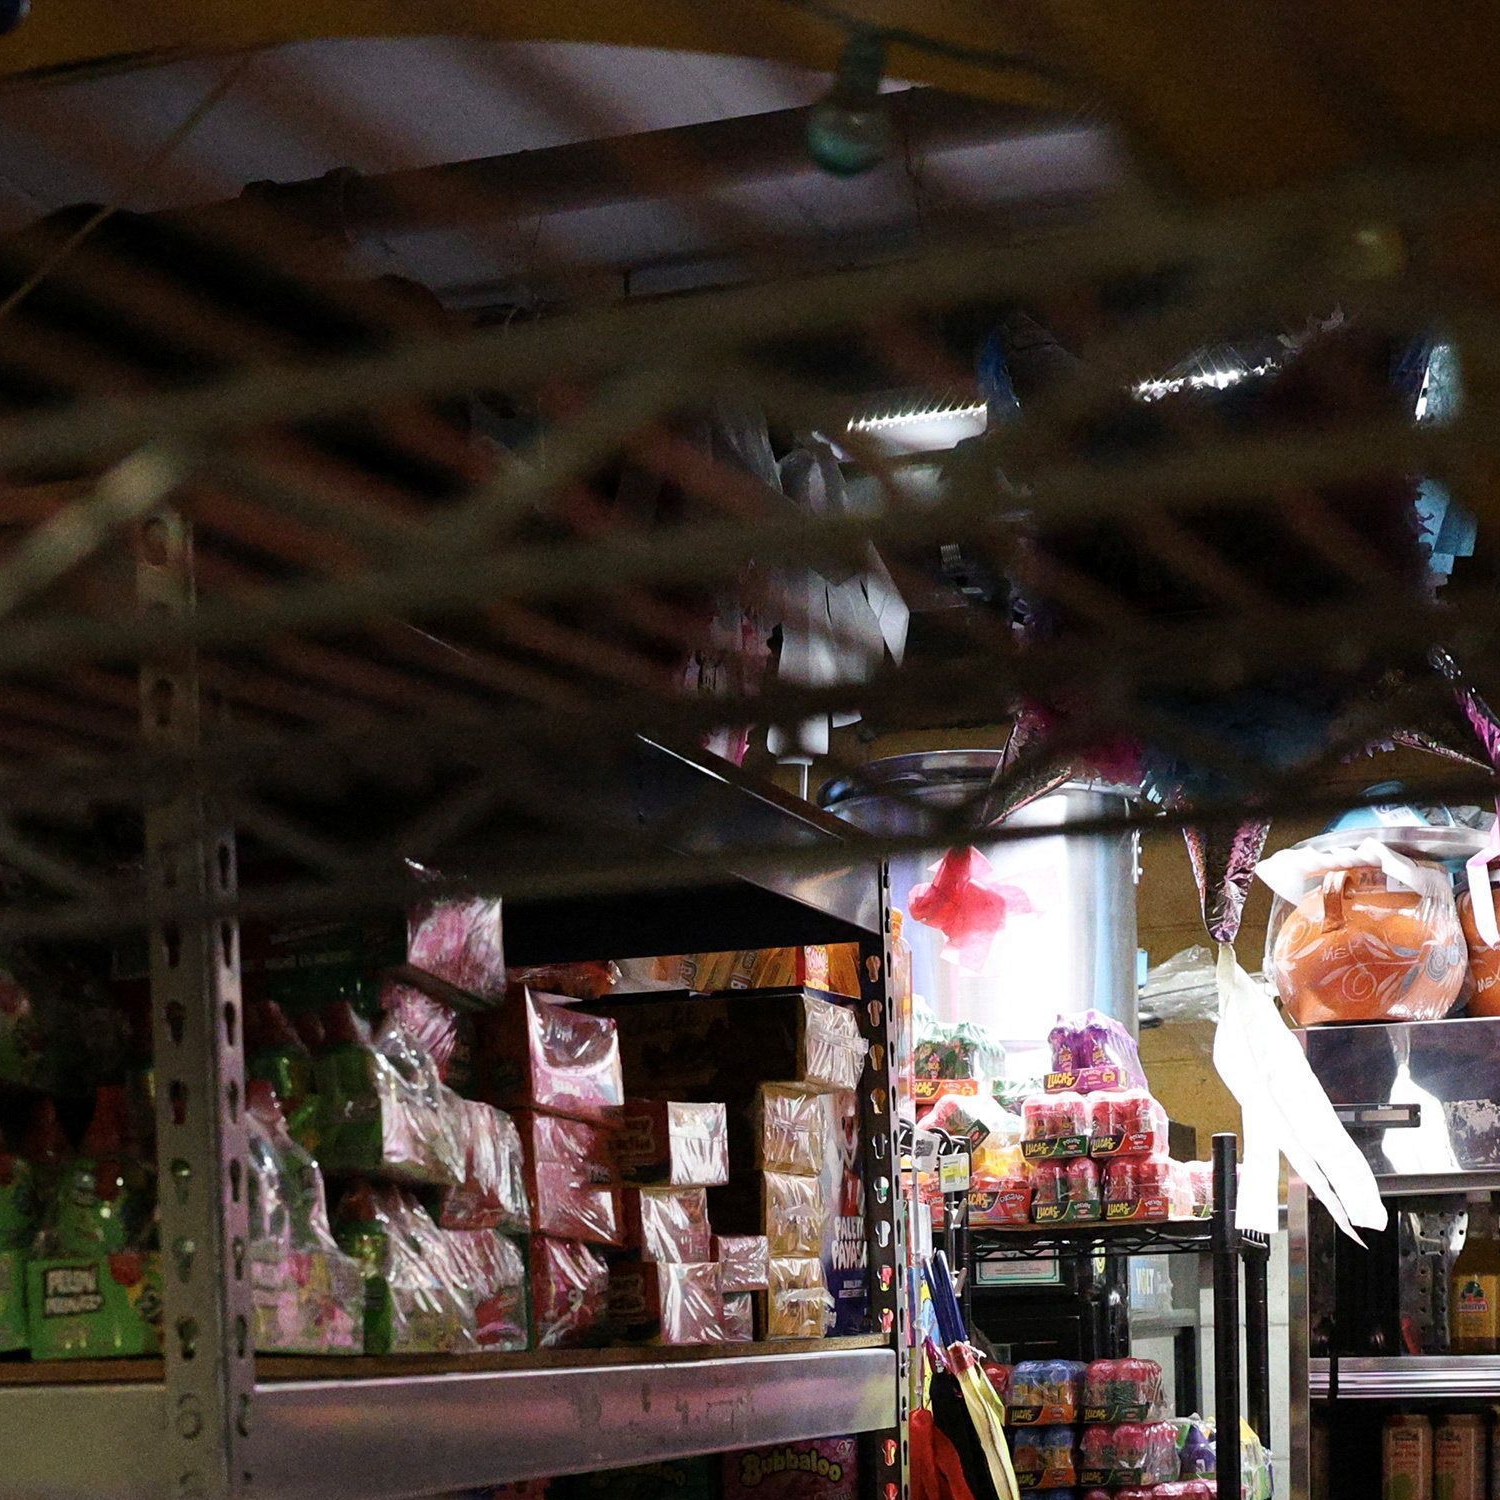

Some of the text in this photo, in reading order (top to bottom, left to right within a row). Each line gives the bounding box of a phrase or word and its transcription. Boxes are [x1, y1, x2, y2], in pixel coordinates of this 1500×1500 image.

[1047, 1072, 1075, 1089] LUCAS
[1025, 1142, 1050, 1155] LUCAS
[1092, 1137, 1116, 1151] LUCAS
[1036, 1206, 1060, 1219] LUCAS
[1107, 1203, 1131, 1217] LUCAS
[740, 1446, 843, 1488] Bubbaloo
